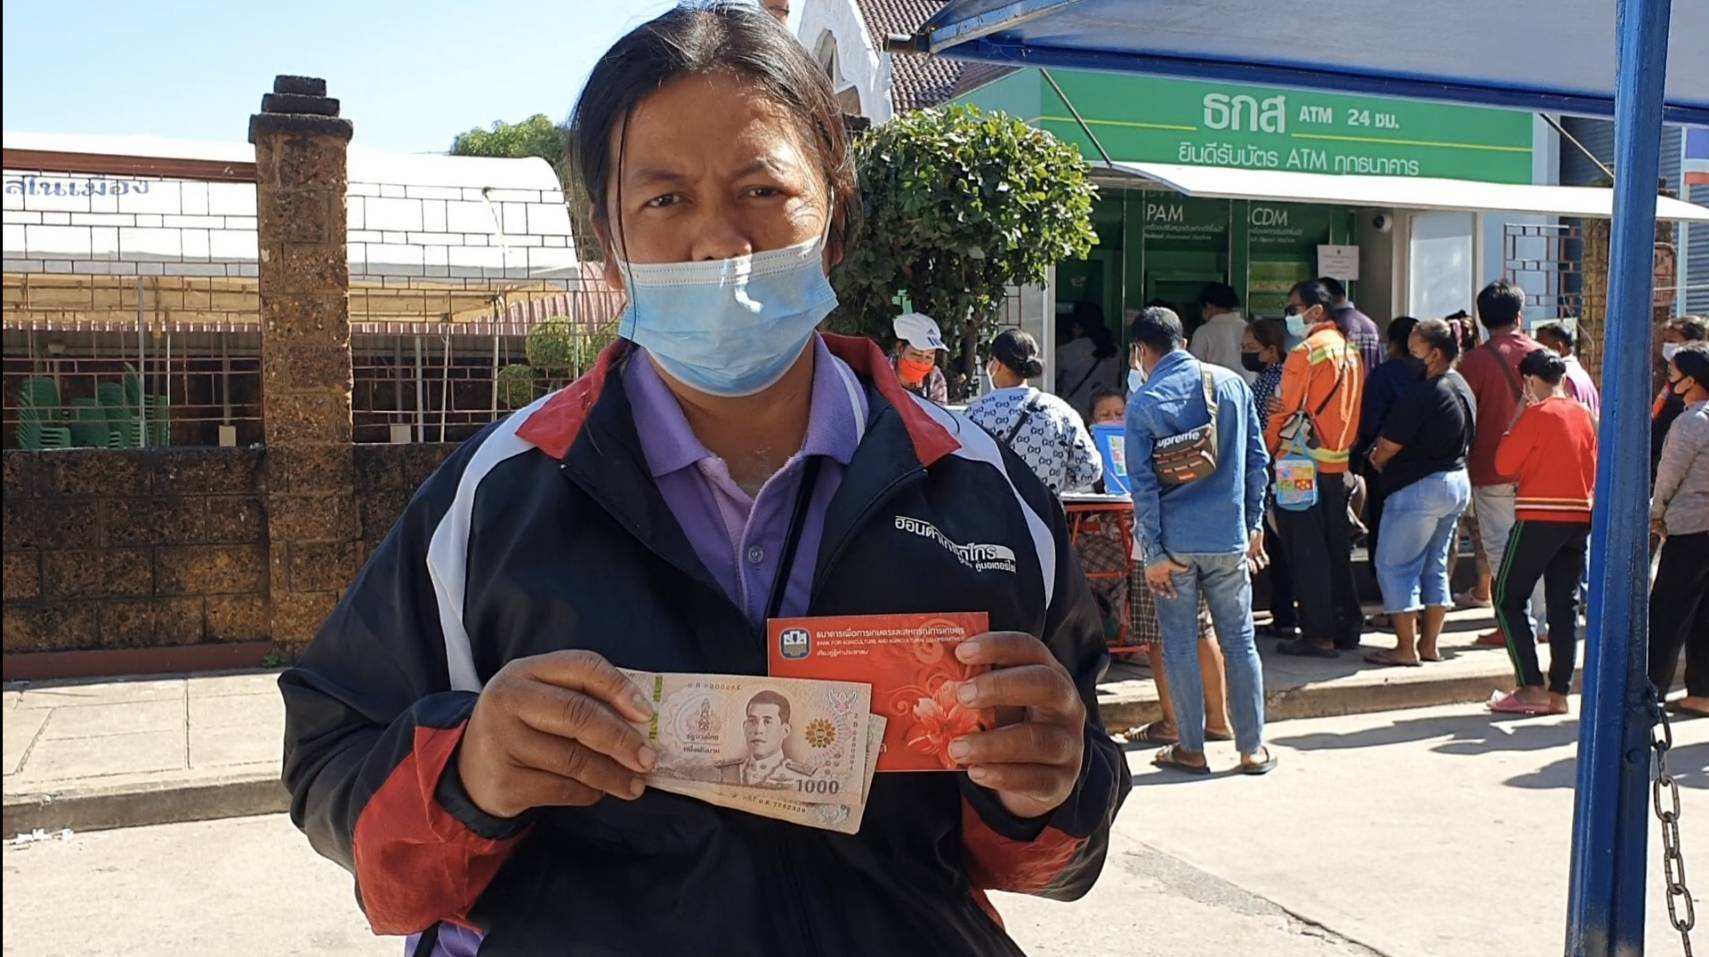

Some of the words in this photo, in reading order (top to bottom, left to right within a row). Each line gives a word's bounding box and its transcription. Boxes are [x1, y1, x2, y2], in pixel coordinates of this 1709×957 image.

[1203, 93, 1286, 133] ธกส
[1299, 105, 1333, 124] ATM
[1347, 108, 1371, 127] 24
[1178, 142, 1279, 168] ยินดีรับบัตร
[1286, 147, 1328, 171] ATM
[1146, 203, 1184, 223] PAM
[1251, 207, 1288, 227] CDM
[796, 779, 839, 794] 1000
